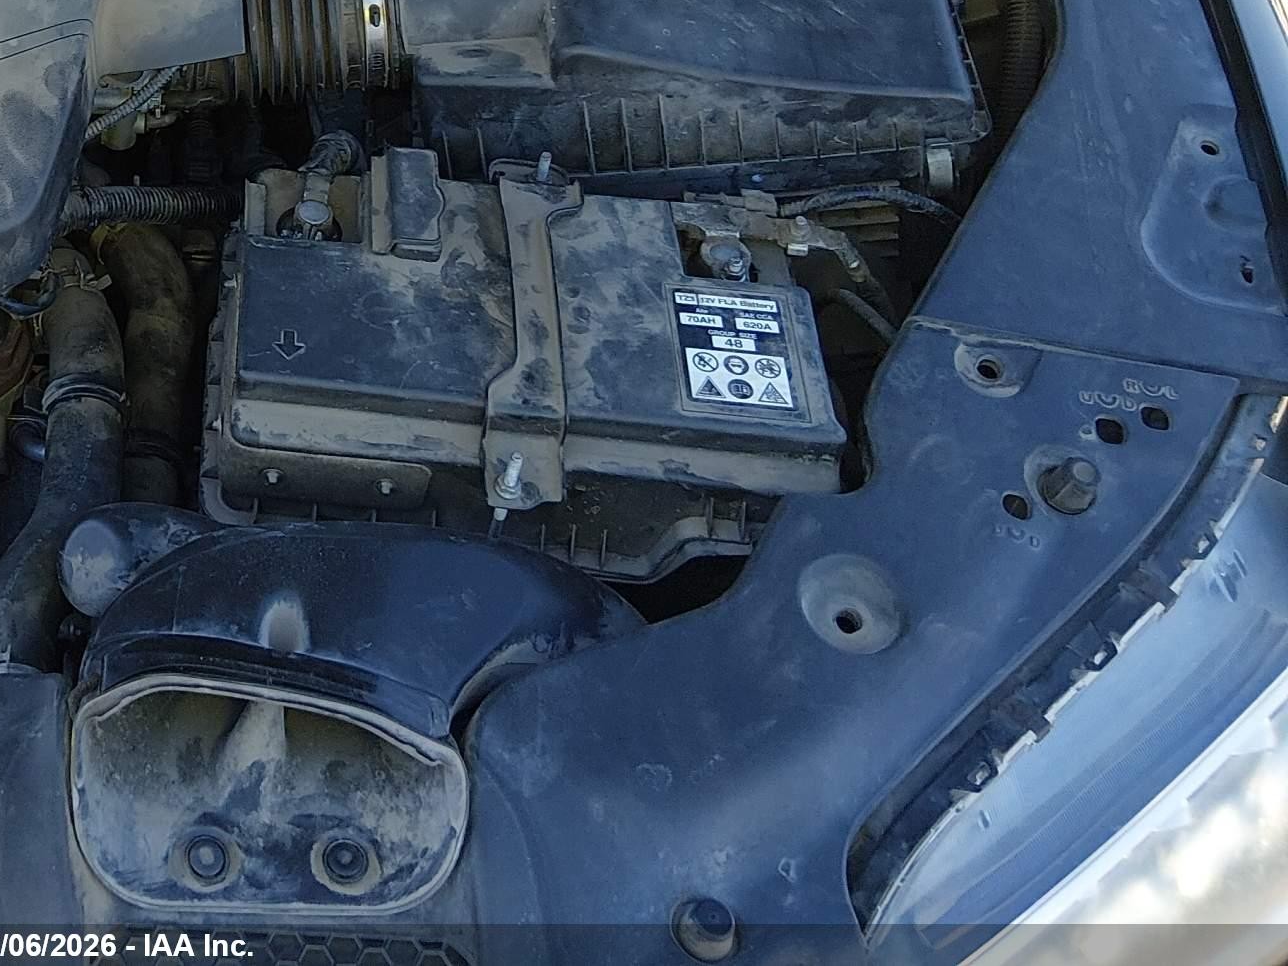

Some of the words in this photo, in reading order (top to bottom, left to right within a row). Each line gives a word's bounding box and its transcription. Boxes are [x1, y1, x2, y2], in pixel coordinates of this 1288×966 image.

[700, 296, 716, 305] 12V
[718, 298, 737, 306] FLA
[740, 300, 775, 311] Battery
[686, 315, 717, 324] 70AH
[743, 321, 773, 331] 620A
[707, 329, 736, 337] GROUP
[739, 332, 758, 340] SIZE
[724, 338, 744, 349] 48
